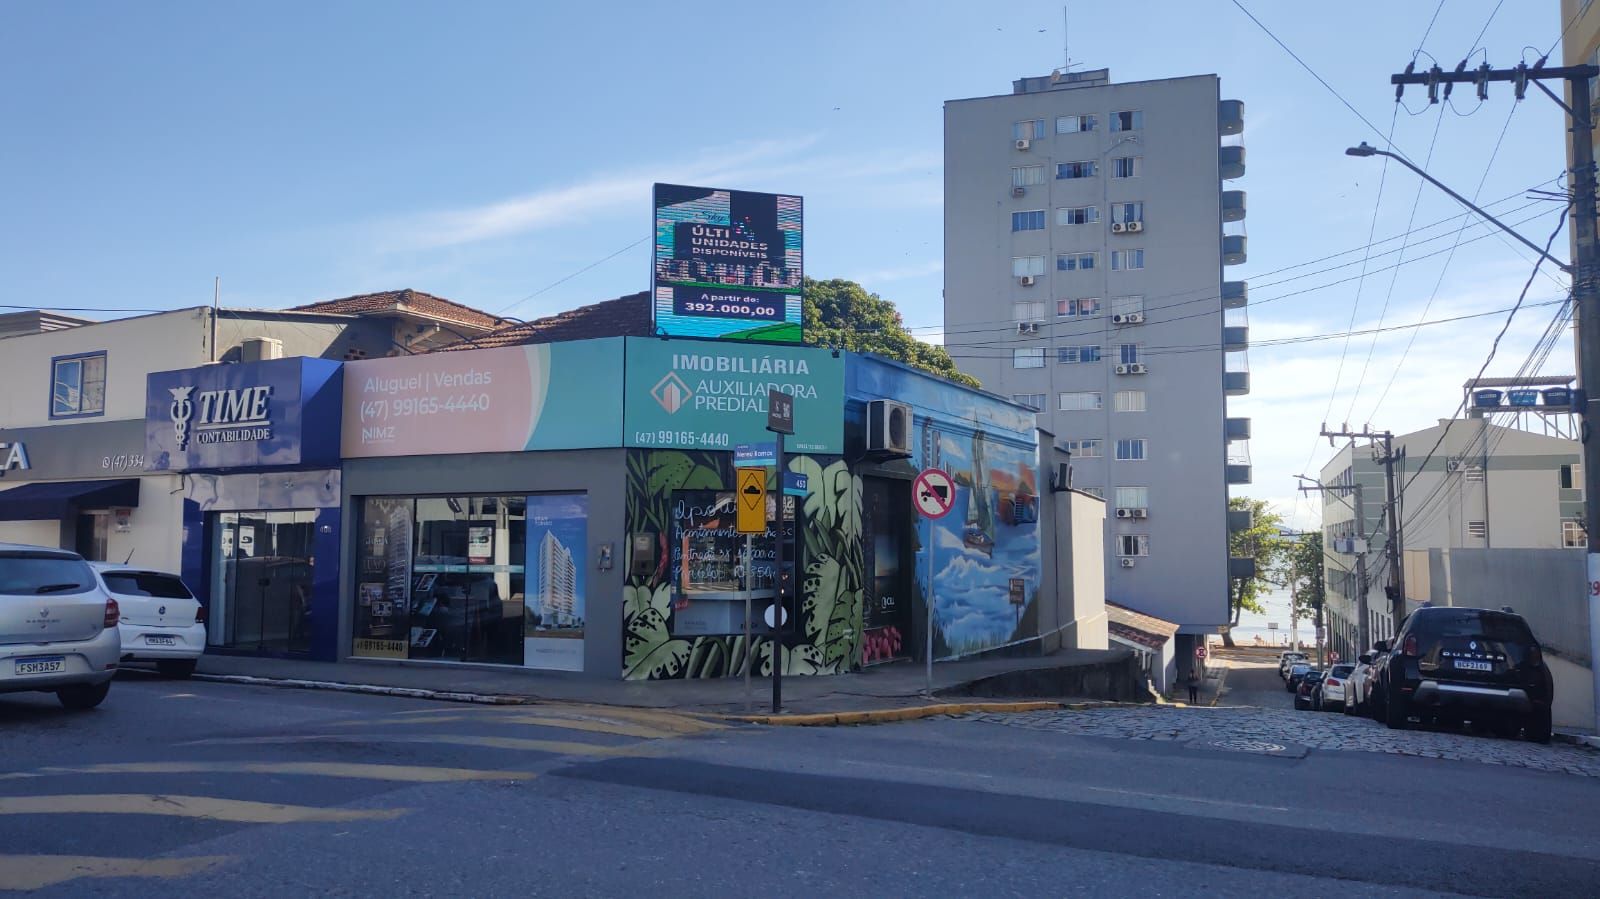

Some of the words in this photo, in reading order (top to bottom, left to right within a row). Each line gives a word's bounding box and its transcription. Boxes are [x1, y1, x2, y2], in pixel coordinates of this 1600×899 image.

[692, 225, 730, 238] ÚLTI
[692, 239, 768, 250] UNIDADES
[692, 248, 768, 259] DISPONÍVEIS
[711, 294, 741, 302] partir
[685, 303, 776, 316] 392.000,00
[672, 354, 809, 375] IMOBILIÁRIA
[363, 372, 422, 394] Aluguel
[433, 368, 492, 388] Vendas
[696, 379, 818, 400] AUXILIADORA
[199, 386, 270, 424] TIME
[360, 400, 389, 422] (47)
[392, 393, 490, 417] 99165-4440
[695, 396, 768, 413] PREDIAL
[197, 428, 271, 444] CONTABILIDADE
[361, 426, 396, 444] NIMZ
[635, 432, 656, 444] (47)
[1442, 651, 1504, 660] DUSTER
[20, 662, 61, 673] FSH3A57
